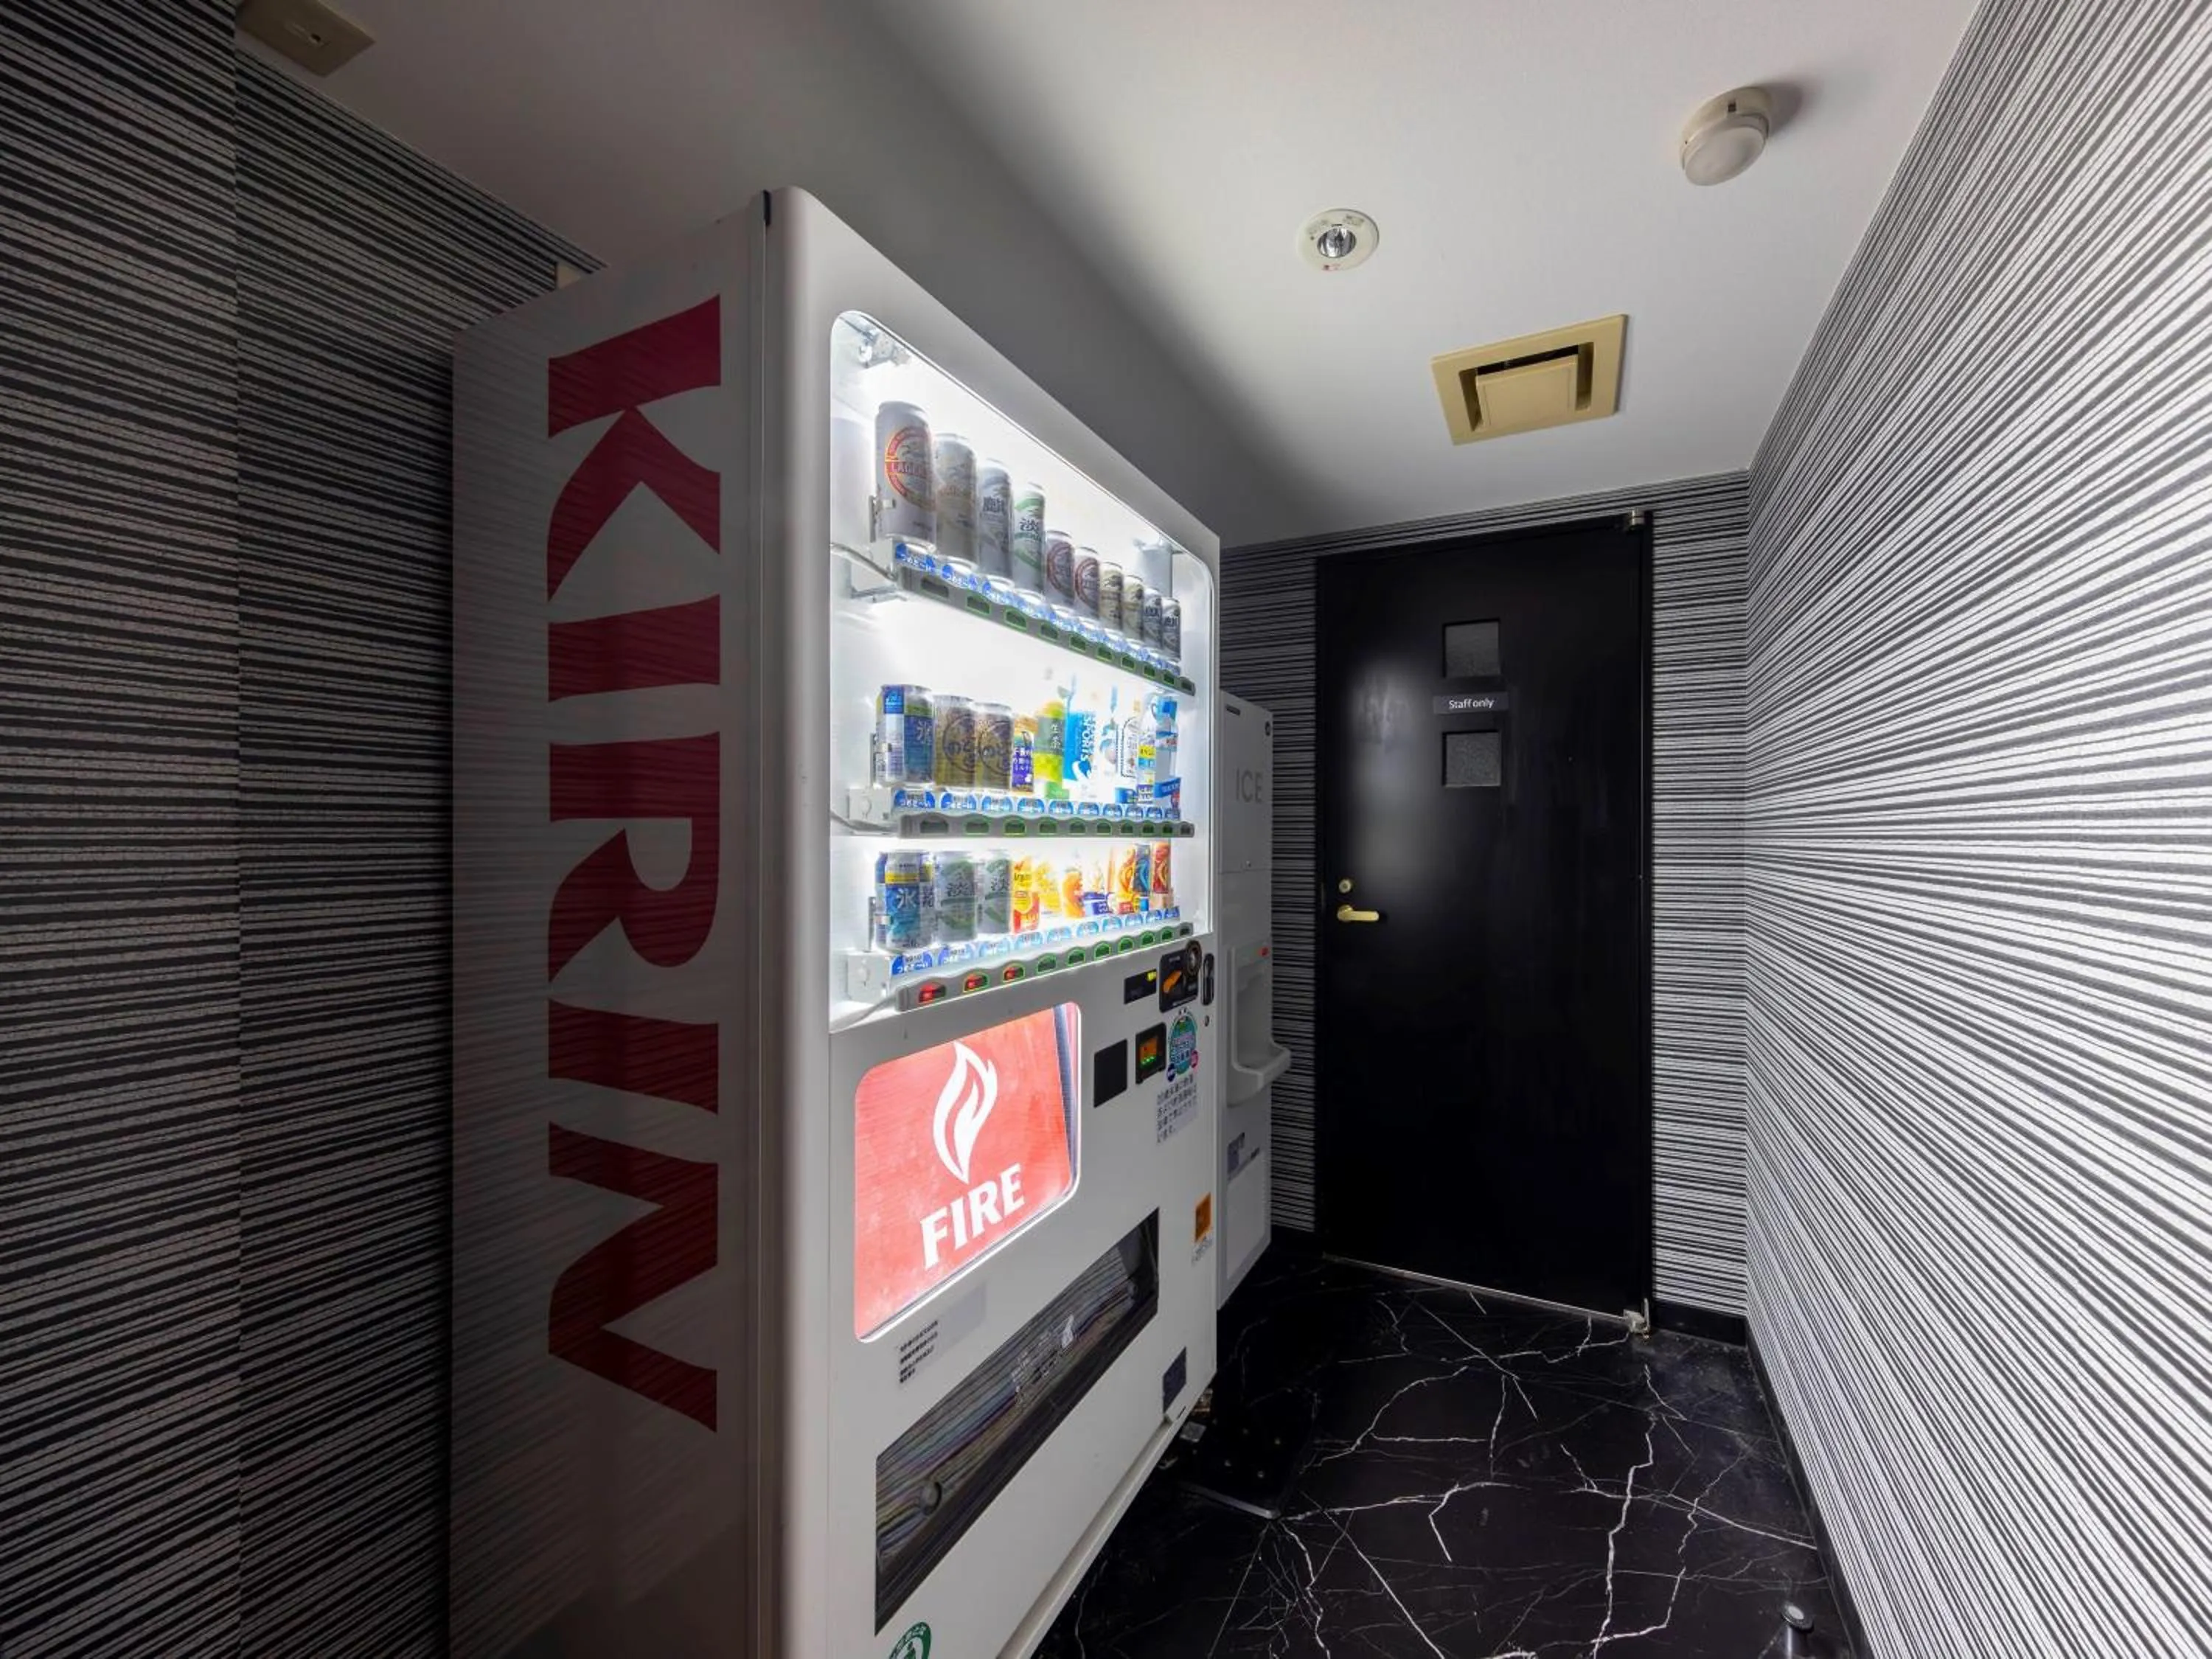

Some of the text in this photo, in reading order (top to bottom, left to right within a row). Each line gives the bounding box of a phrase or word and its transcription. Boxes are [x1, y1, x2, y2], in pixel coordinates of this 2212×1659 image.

[1449, 698, 1495, 709] Staff only
[1236, 768, 1263, 804] ICE
[548, 295, 721, 1432] KIRIN
[920, 1164, 1026, 1270] FIRE
